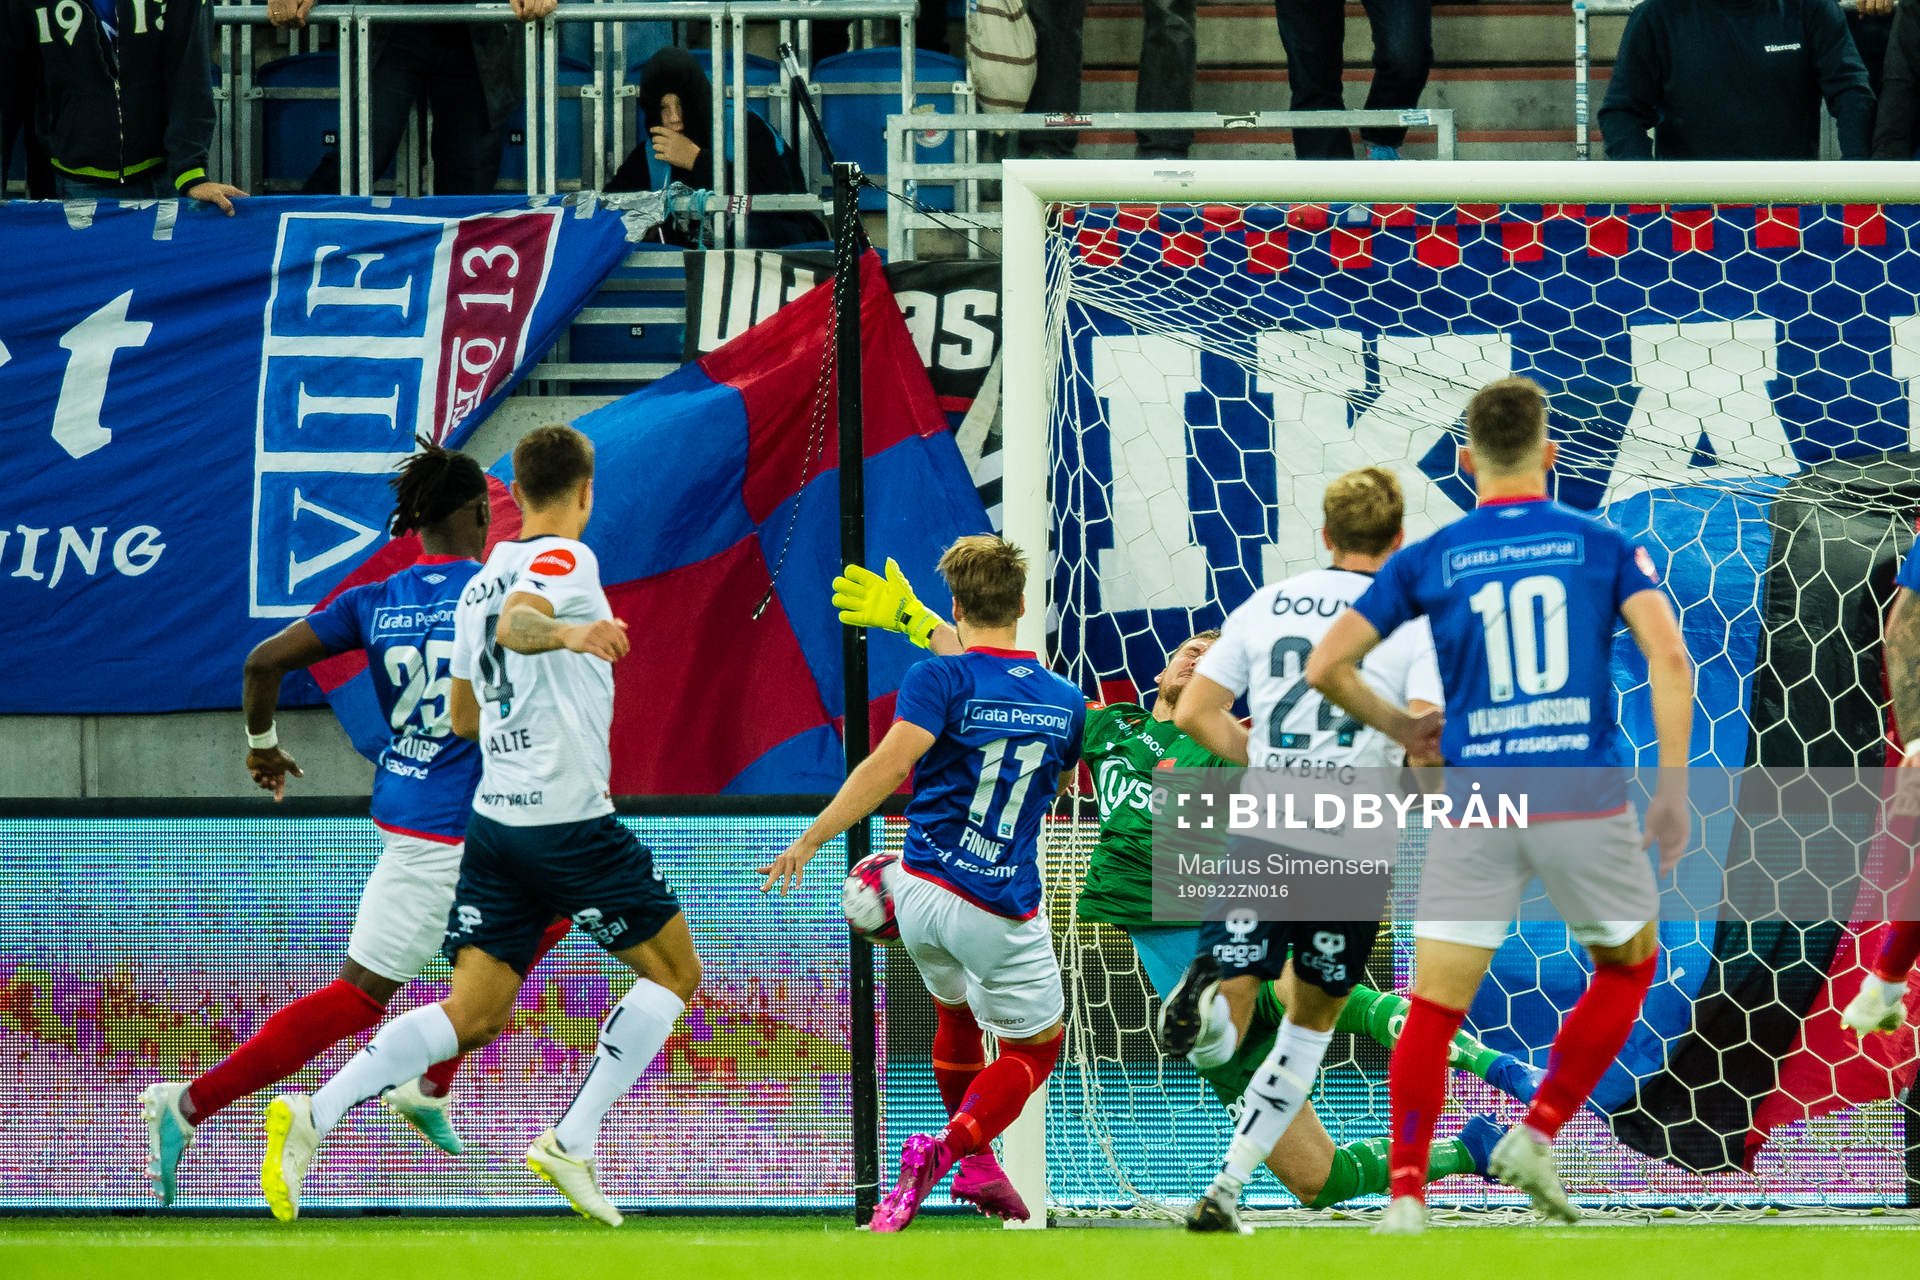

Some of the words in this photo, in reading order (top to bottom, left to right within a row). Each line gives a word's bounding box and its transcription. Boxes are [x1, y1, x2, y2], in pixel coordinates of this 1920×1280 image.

[35, 0, 83, 46] 19
[457, 245, 519, 312] 13
[0, 288, 153, 459] t
[0, 524, 167, 589] ING
[378, 612, 413, 629] Grata
[1272, 590, 1349, 617] bou
[479, 614, 515, 719] 4
[1469, 575, 1569, 703] 10
[384, 640, 452, 738] 25
[487, 728, 532, 755] ALTE
[971, 706, 1009, 723] Grata
[1011, 710, 1068, 731] Personal
[968, 738, 1048, 840] 11
[959, 826, 1005, 864] FINNE
[1212, 938, 1269, 968] regal
